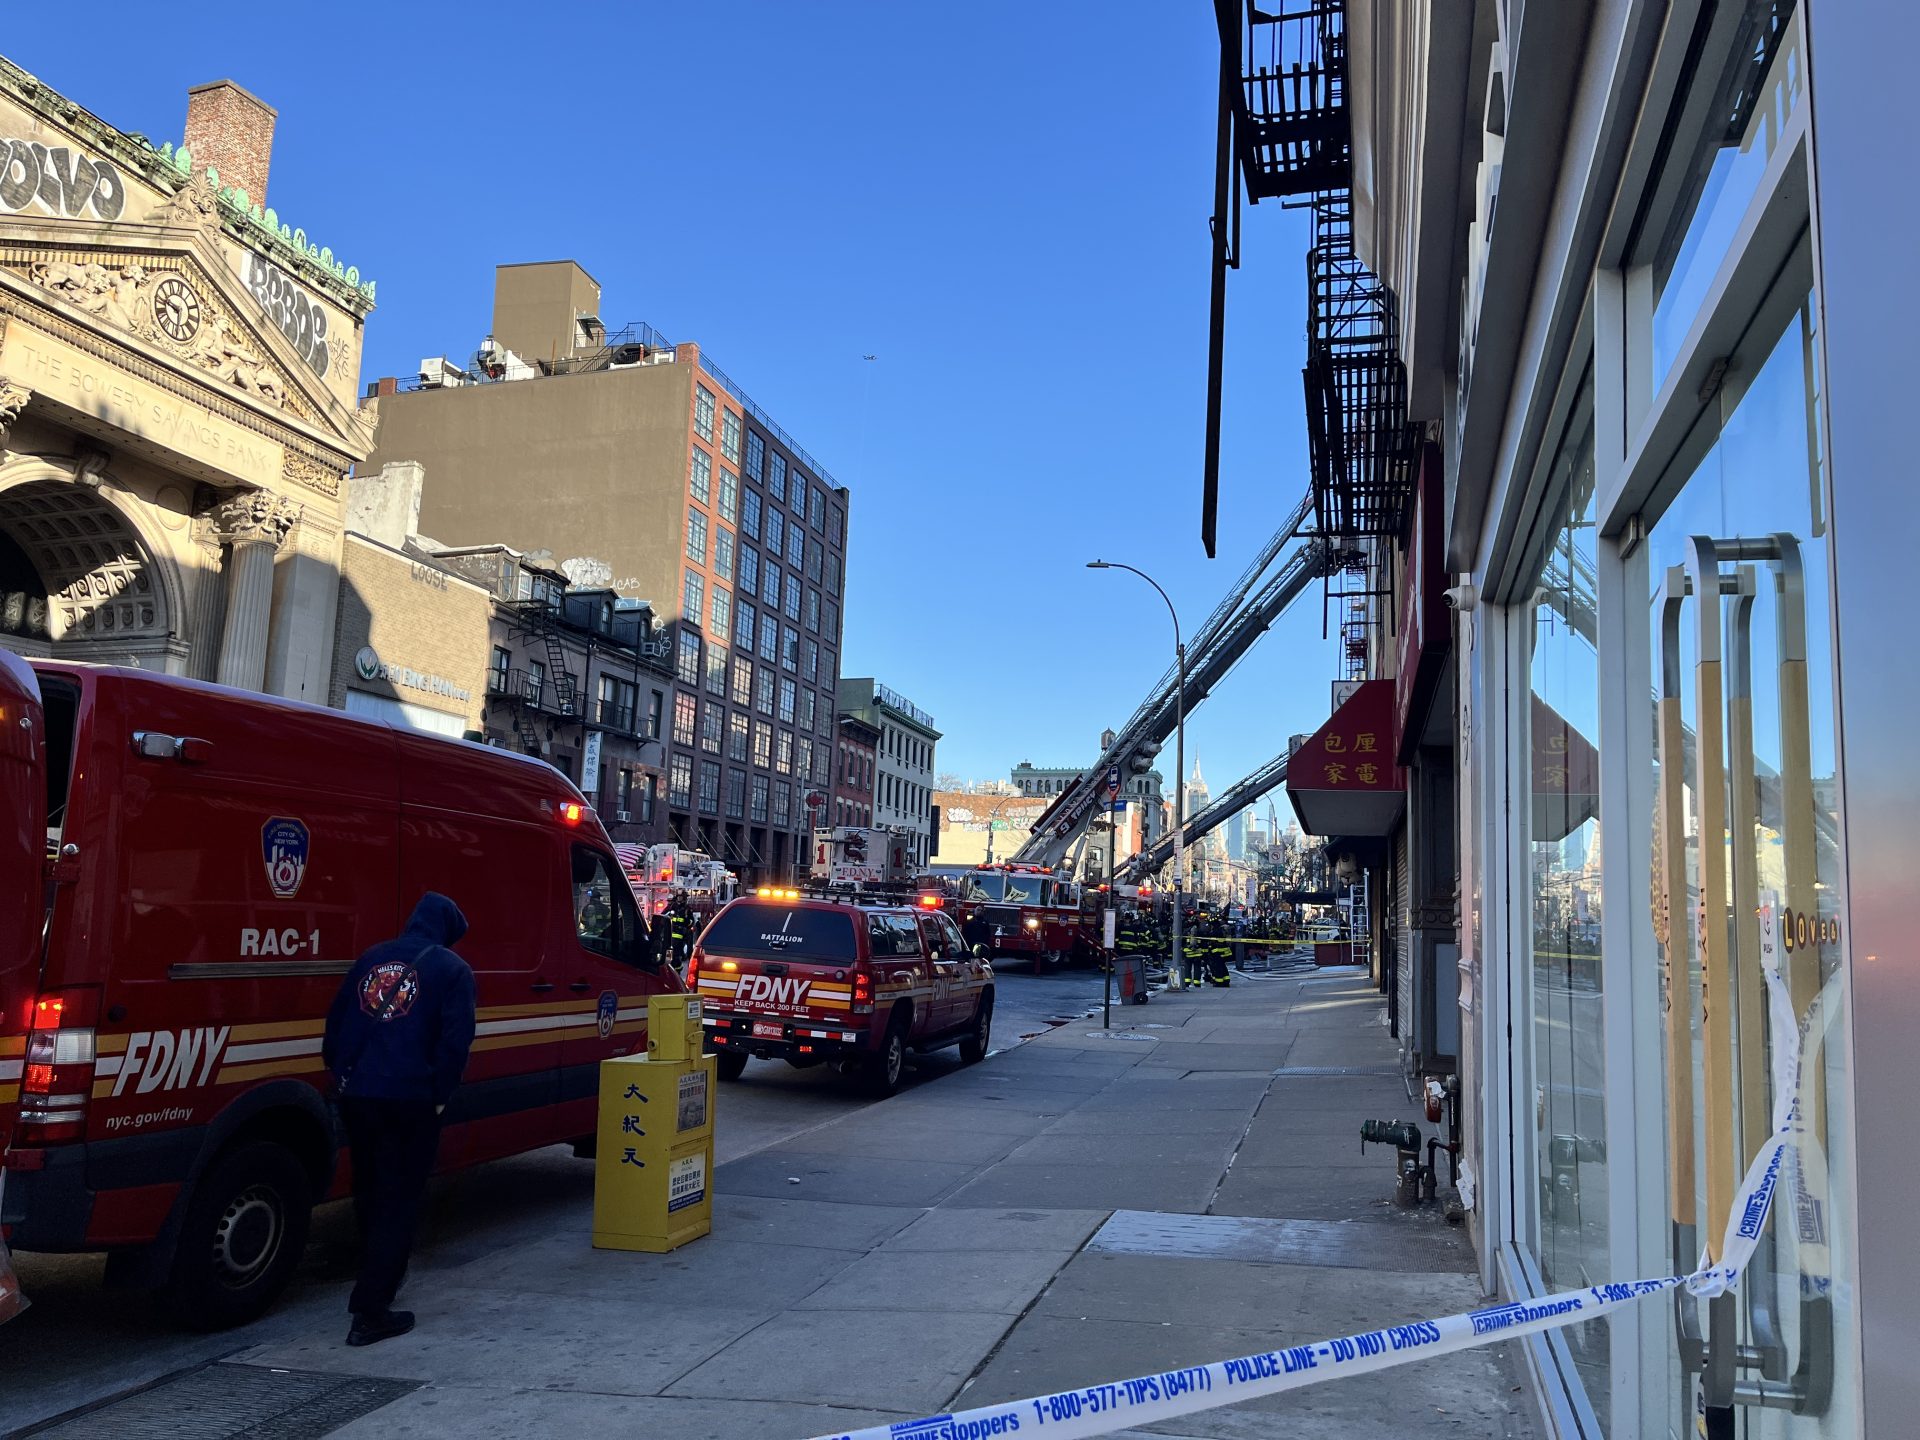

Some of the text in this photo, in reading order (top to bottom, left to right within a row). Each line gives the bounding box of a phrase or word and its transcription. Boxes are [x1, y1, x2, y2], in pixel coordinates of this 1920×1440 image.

[0, 138, 126, 221] OLVO
[22, 345, 63, 380] THE
[69, 366, 147, 416] BOWERY
[152, 403, 221, 450] SAVINGS
[411, 561, 449, 591] LOOSE
[609, 577, 641, 591] ACAB
[1323, 732, 1379, 754] 包厘
[1323, 762, 1379, 785] 家電
[817, 844, 826, 865] 1
[893, 847, 903, 868] 1
[240, 928, 320, 956] RAC-1
[761, 933, 803, 943] BATTALION
[735, 974, 811, 1005] FDNY
[734, 999, 754, 1008] KEEP
[755, 1001, 776, 1010] BACK
[777, 1003, 790, 1011] 200
[791, 1004, 810, 1013] FEET
[111, 1025, 231, 1097] FDNY
[106, 1107, 194, 1131] nyc.gov/fdny
[620, 1083, 649, 1169] 大紀元
[1477, 1312, 1515, 1334] CRIME
[1032, 1376, 1161, 1425] 1-800-577-TIPS
[1161, 1366, 1212, 1400] (8477)
[1223, 1353, 1281, 1385] POLICE
[1279, 1345, 1318, 1373] LINE
[1329, 1338, 1355, 1363] DO
[1354, 1330, 1387, 1358] NOT
[1387, 1320, 1441, 1351] CROSS
